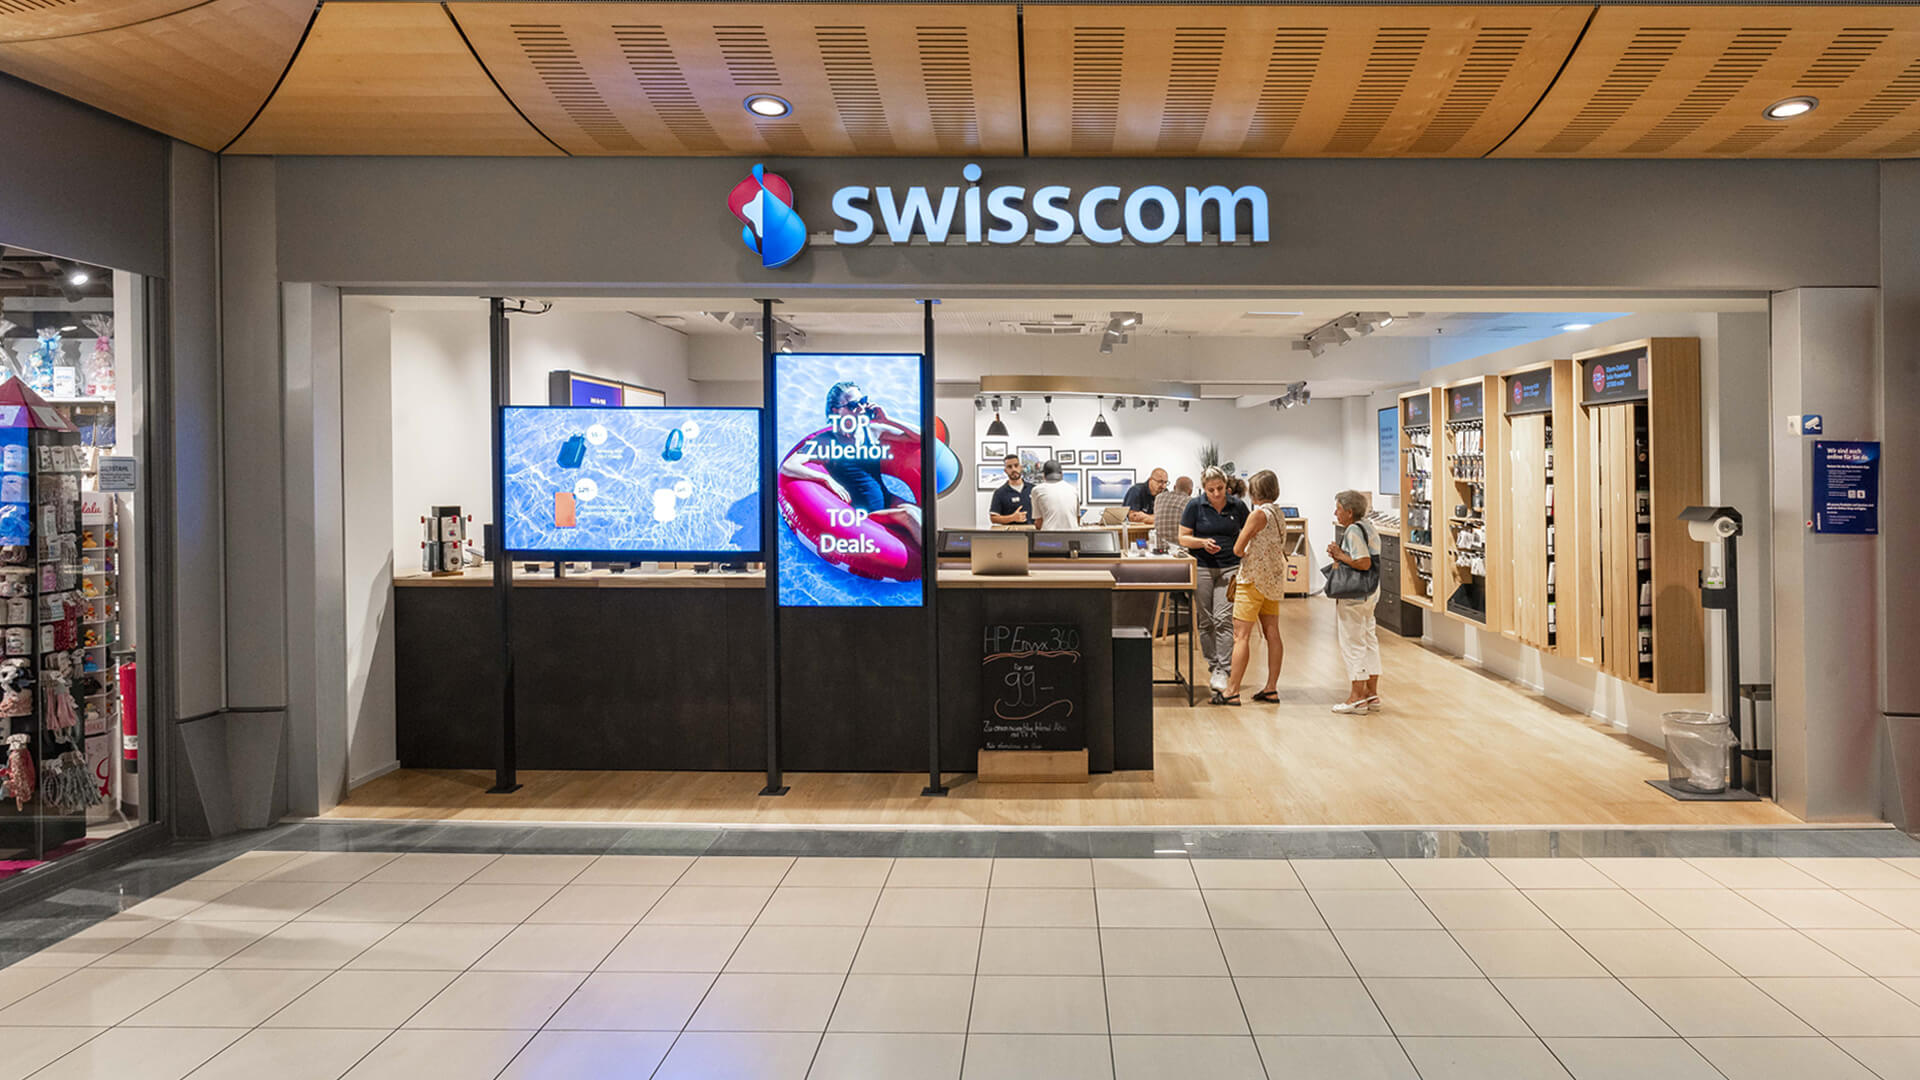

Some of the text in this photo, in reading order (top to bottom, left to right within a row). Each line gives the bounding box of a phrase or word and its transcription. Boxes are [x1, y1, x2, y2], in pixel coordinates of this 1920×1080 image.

[832, 163, 1270, 245] swisscom
[828, 414, 870, 433] TOP
[805, 439, 894, 460] Zubehör.
[826, 508, 868, 527] TOP
[820, 533, 881, 554] Deals.
[984, 625, 1010, 653] HP
